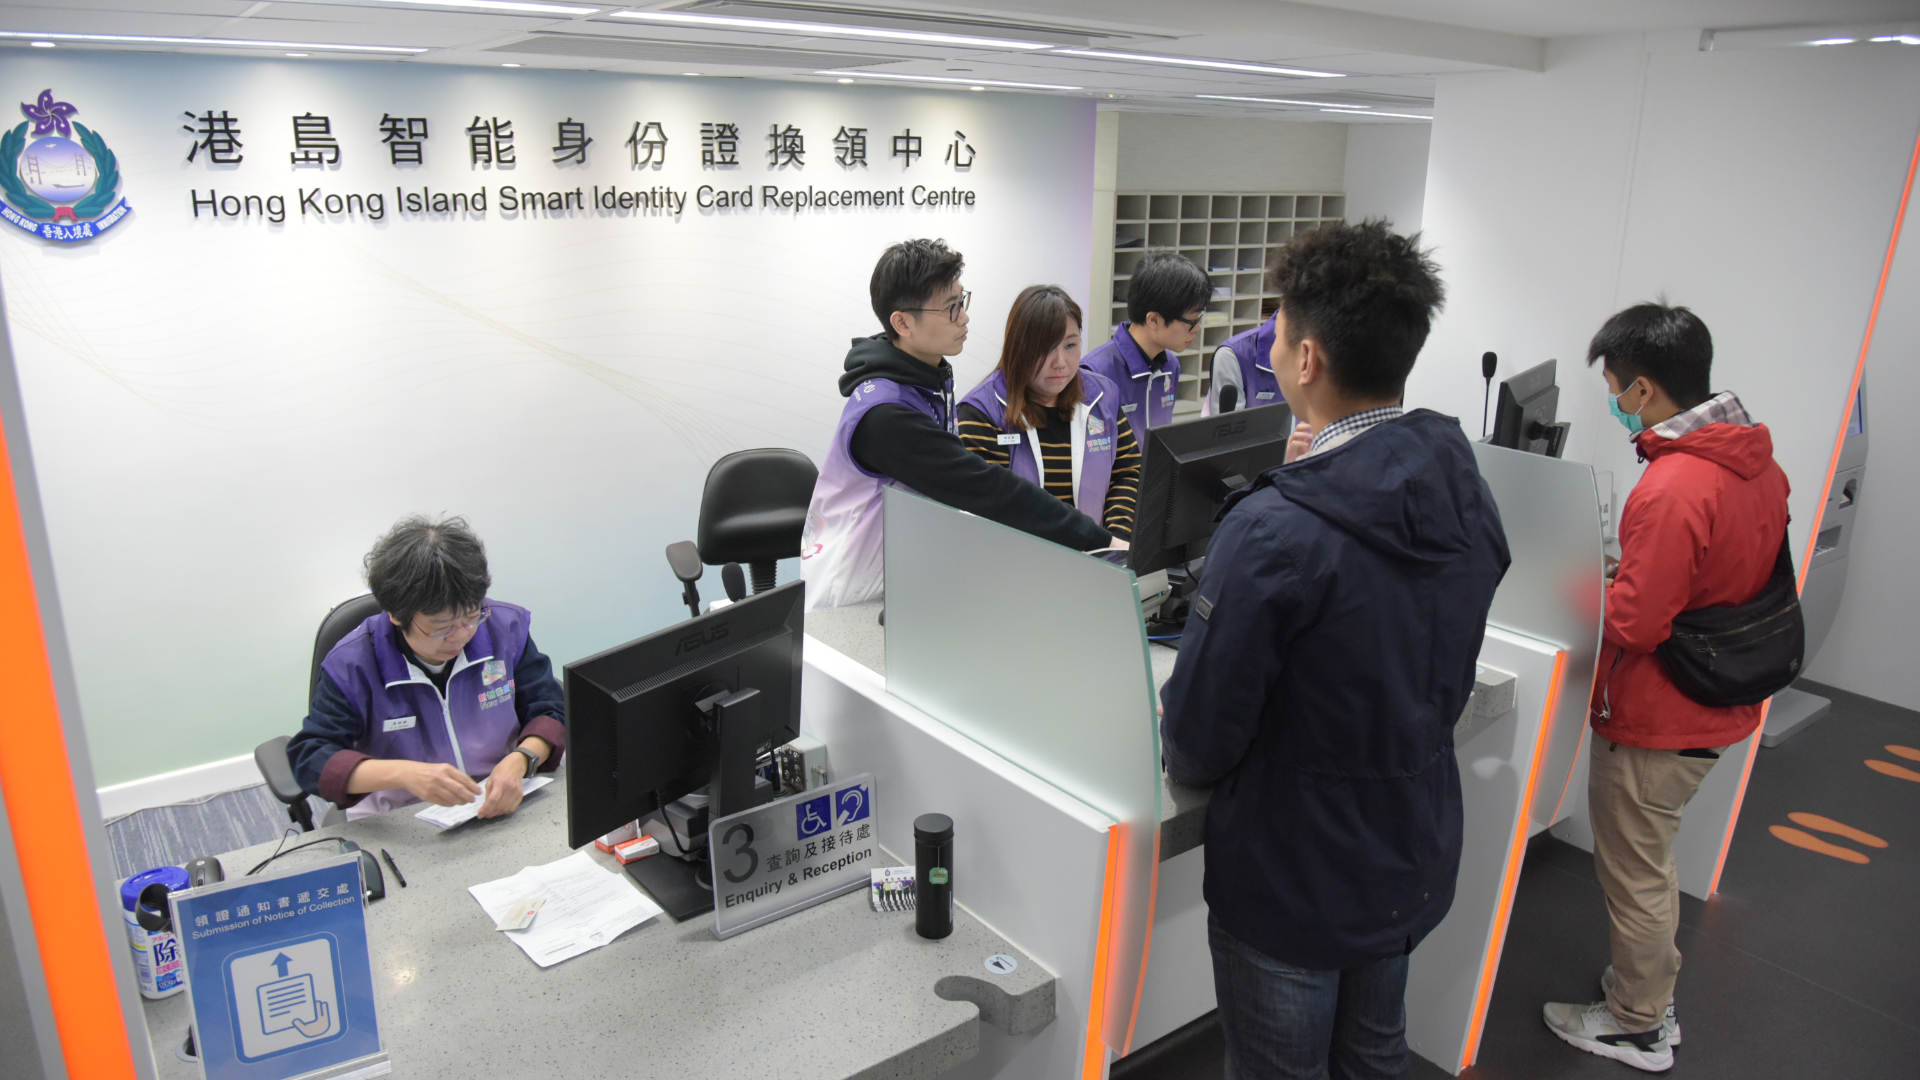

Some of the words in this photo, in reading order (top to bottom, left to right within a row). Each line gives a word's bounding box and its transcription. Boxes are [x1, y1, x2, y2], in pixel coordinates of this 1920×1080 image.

[183, 110, 976, 168] 港島智能身份證換領中心
[1, 206, 20, 224] HONG
[18, 215, 38, 233] KONG
[95, 204, 128, 231] IMMIGRATION
[191, 188, 286, 223] Hong
[298, 187, 385, 220] Kong
[396, 185, 488, 212] Island
[499, 185, 584, 211] Smart
[593, 184, 687, 215] Identity
[696, 184, 753, 208] Card
[761, 184, 905, 213] Replacement
[911, 184, 976, 206] Centre
[42, 222, 94, 240] 香港入境處
[1212, 420, 1247, 440] ASUS
[674, 620, 730, 657] ASUS
[721, 822, 759, 884] 3
[766, 823, 871, 873] 查詢及接待處
[724, 879, 783, 909] Enquiry
[787, 872, 798, 886] &
[802, 848, 872, 881] Reception
[191, 919, 250, 940] Submission
[252, 914, 263, 925] of
[264, 910, 295, 923] Notice
[297, 905, 308, 915] of
[309, 895, 355, 912] Collection
[194, 882, 350, 928] 領證通知書遞交處
[153, 938, 178, 966] 除
